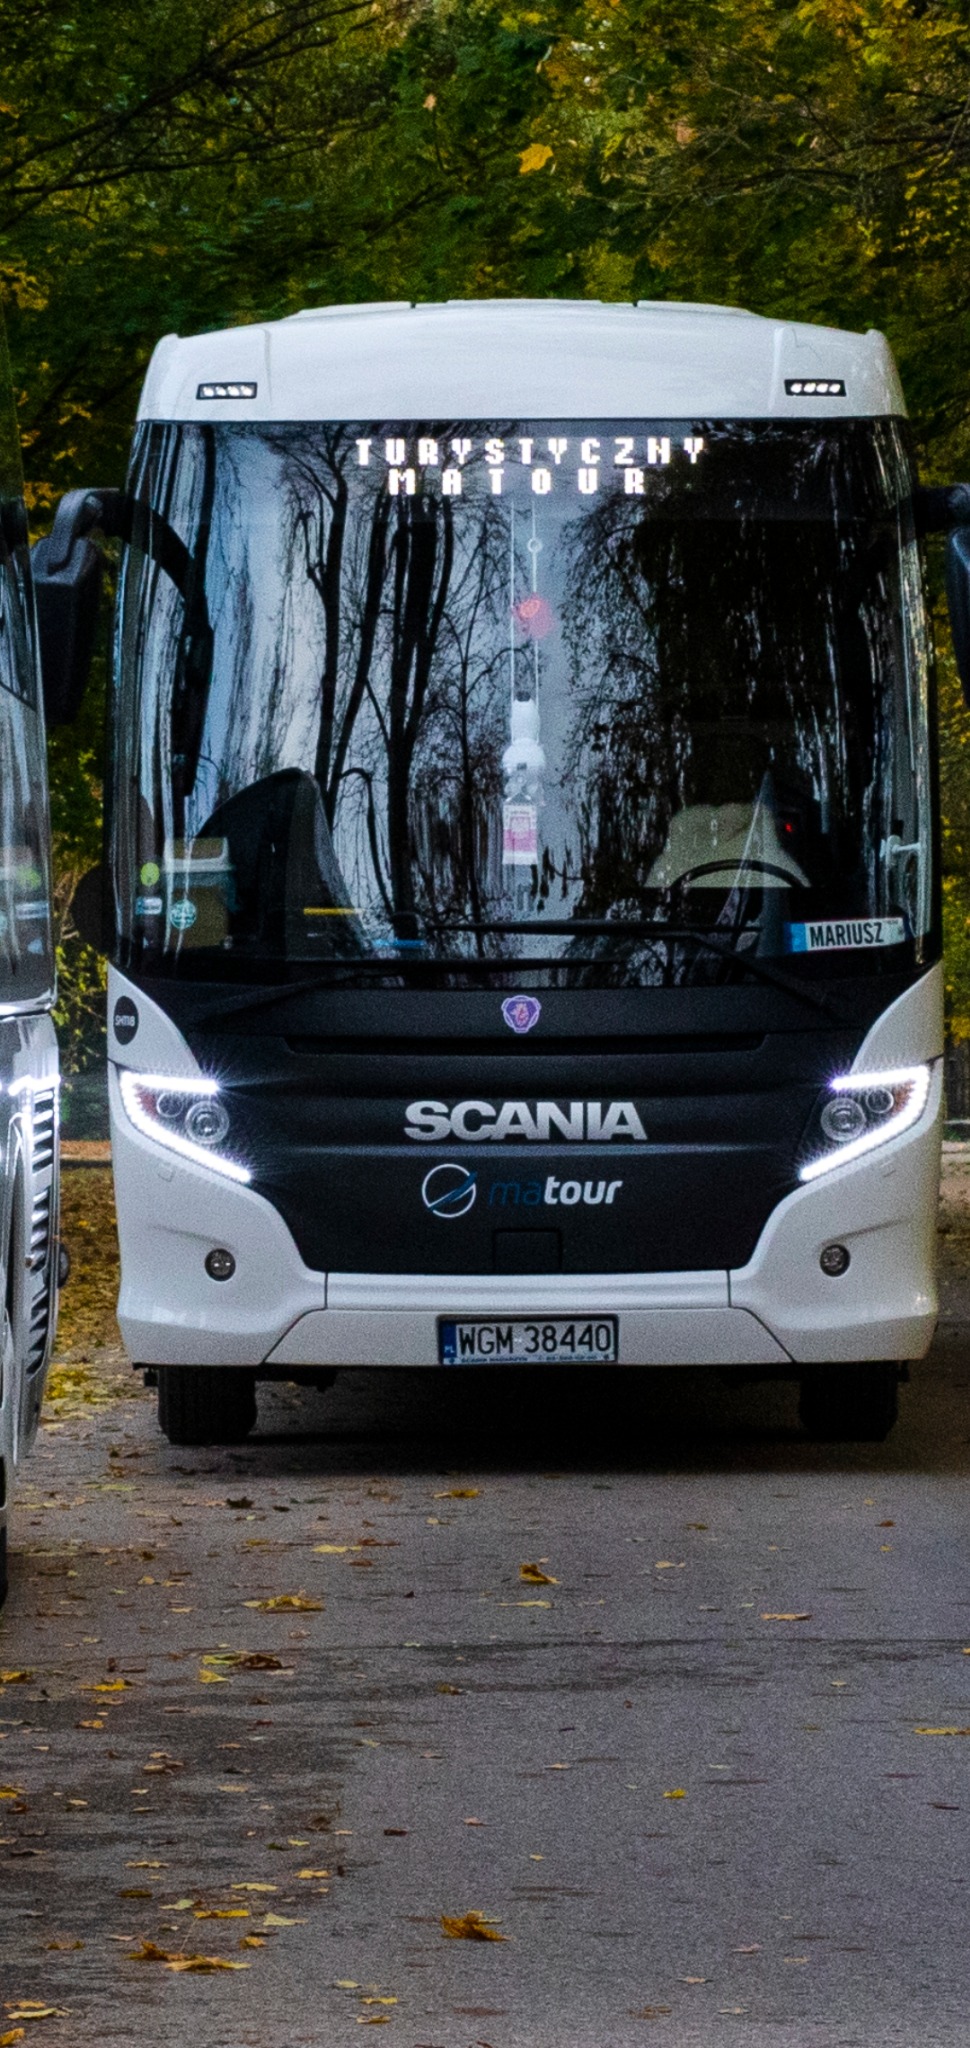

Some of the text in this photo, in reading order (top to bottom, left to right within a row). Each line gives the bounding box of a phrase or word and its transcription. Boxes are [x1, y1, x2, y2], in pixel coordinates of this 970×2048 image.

[355, 438, 704, 466] TURYSTYCZNY
[388, 468, 645, 496] MATOUR
[809, 922, 885, 947] MARIUSZ
[403, 1100, 648, 1141] SCANIA
[488, 1176, 624, 1206] matour
[458, 1324, 612, 1355] WGM 38440
